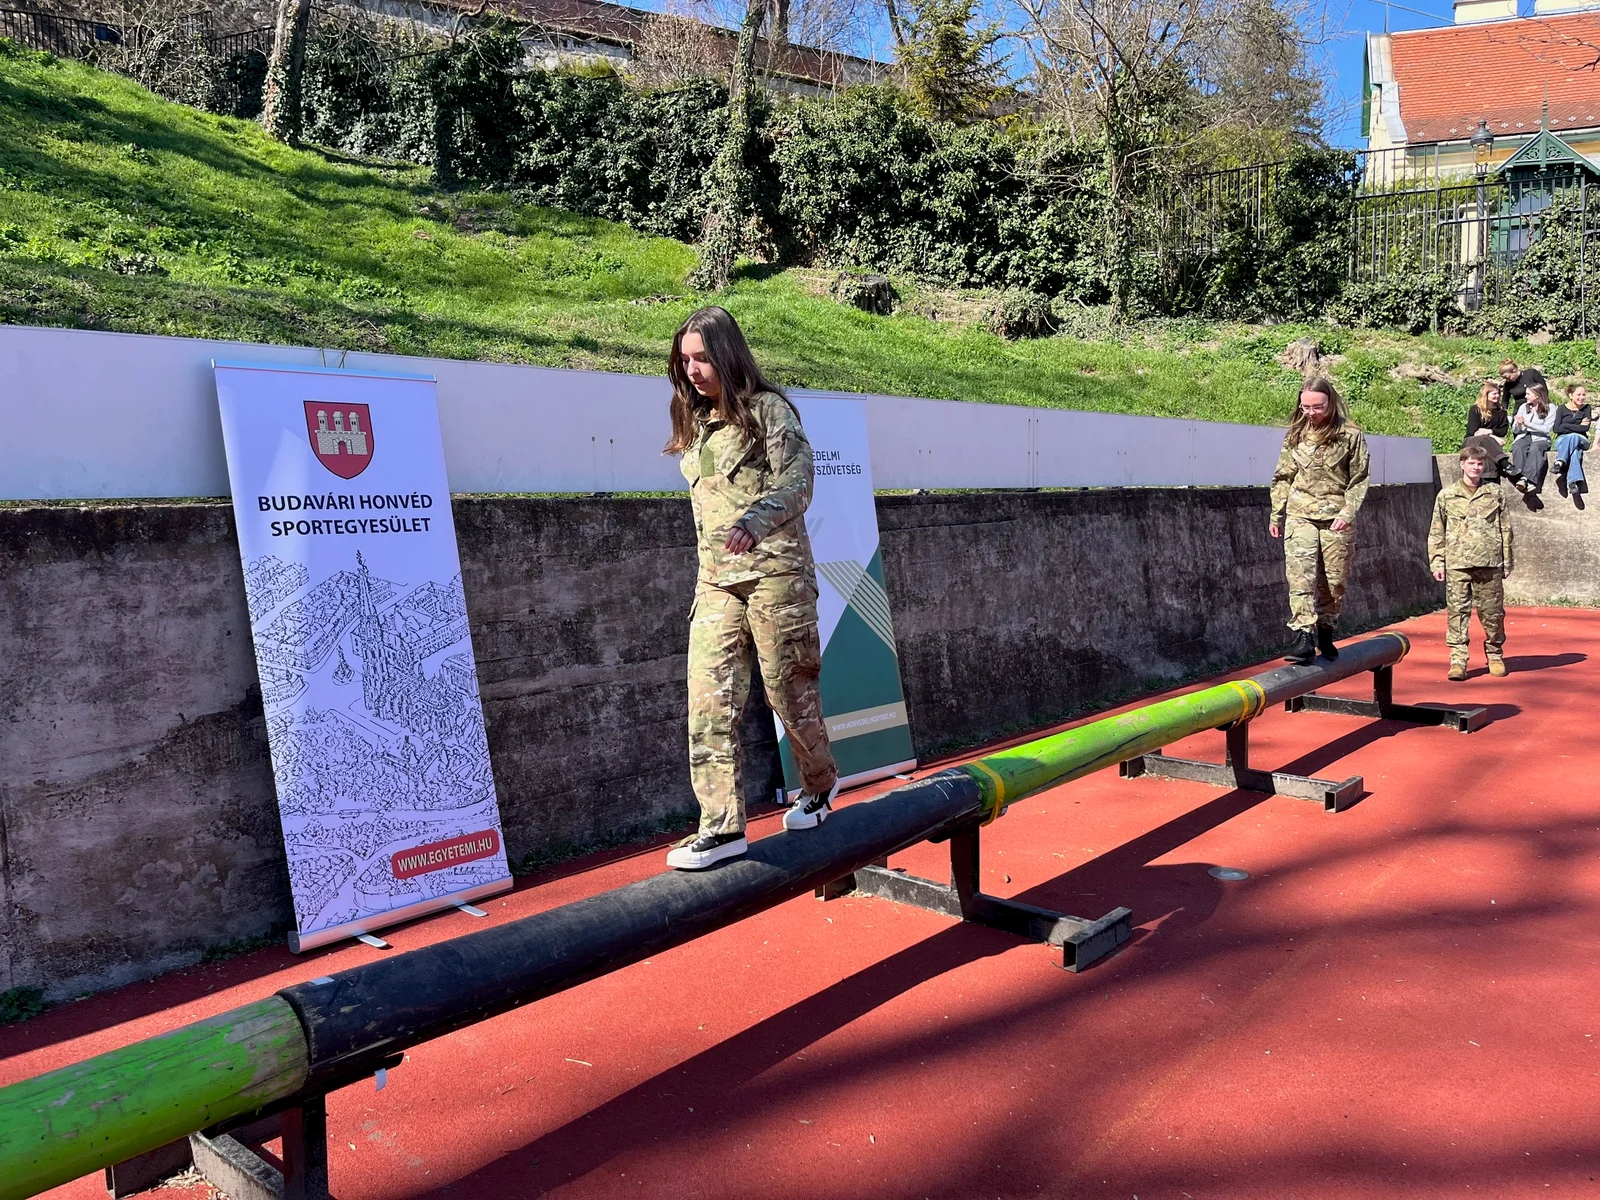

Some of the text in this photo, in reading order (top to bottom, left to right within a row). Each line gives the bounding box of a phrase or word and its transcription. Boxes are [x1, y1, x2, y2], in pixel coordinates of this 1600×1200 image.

[258, 492, 433, 511] BUDAVÁRI HONVÉD
[271, 516, 431, 536] SPORTEGYESÜLET
[397, 837, 493, 872] WWW.EGYETEMI.HU
